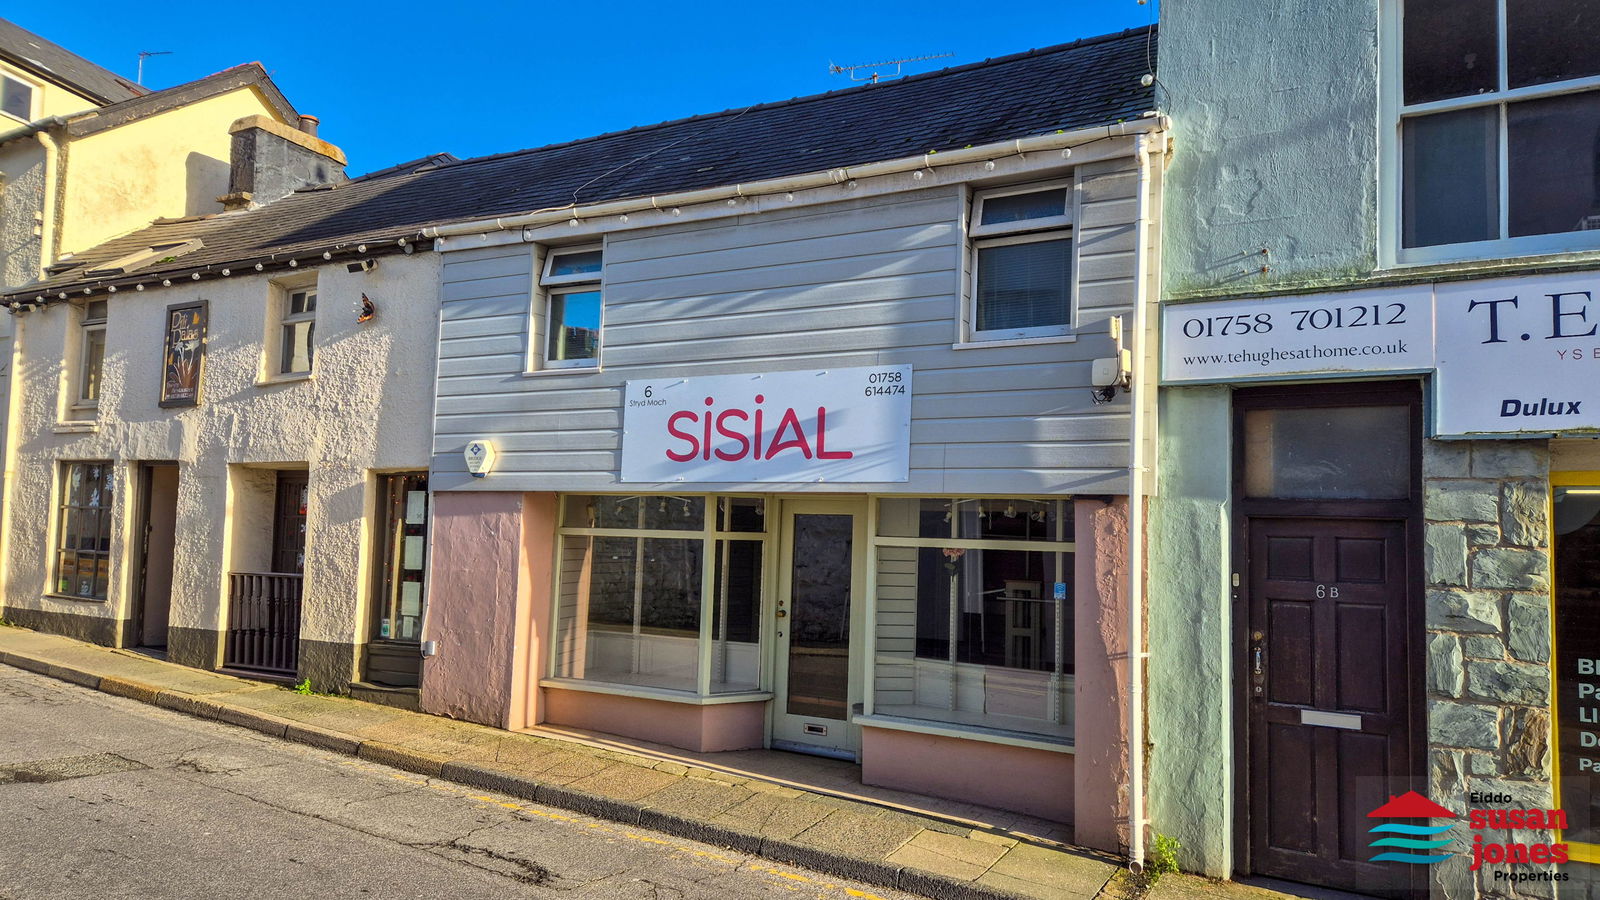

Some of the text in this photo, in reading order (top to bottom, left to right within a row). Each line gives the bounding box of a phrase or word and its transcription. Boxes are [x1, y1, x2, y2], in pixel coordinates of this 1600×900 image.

[1183, 302, 1406, 339] 01758 701212
[1183, 339, 1408, 366] www.tehughesathome.co.uk
[868, 372, 902, 383] 01758
[644, 385, 652, 398] 6
[864, 385, 906, 397] 614474
[647, 398, 667, 407] Moch
[1500, 398, 1582, 417] Dulux
